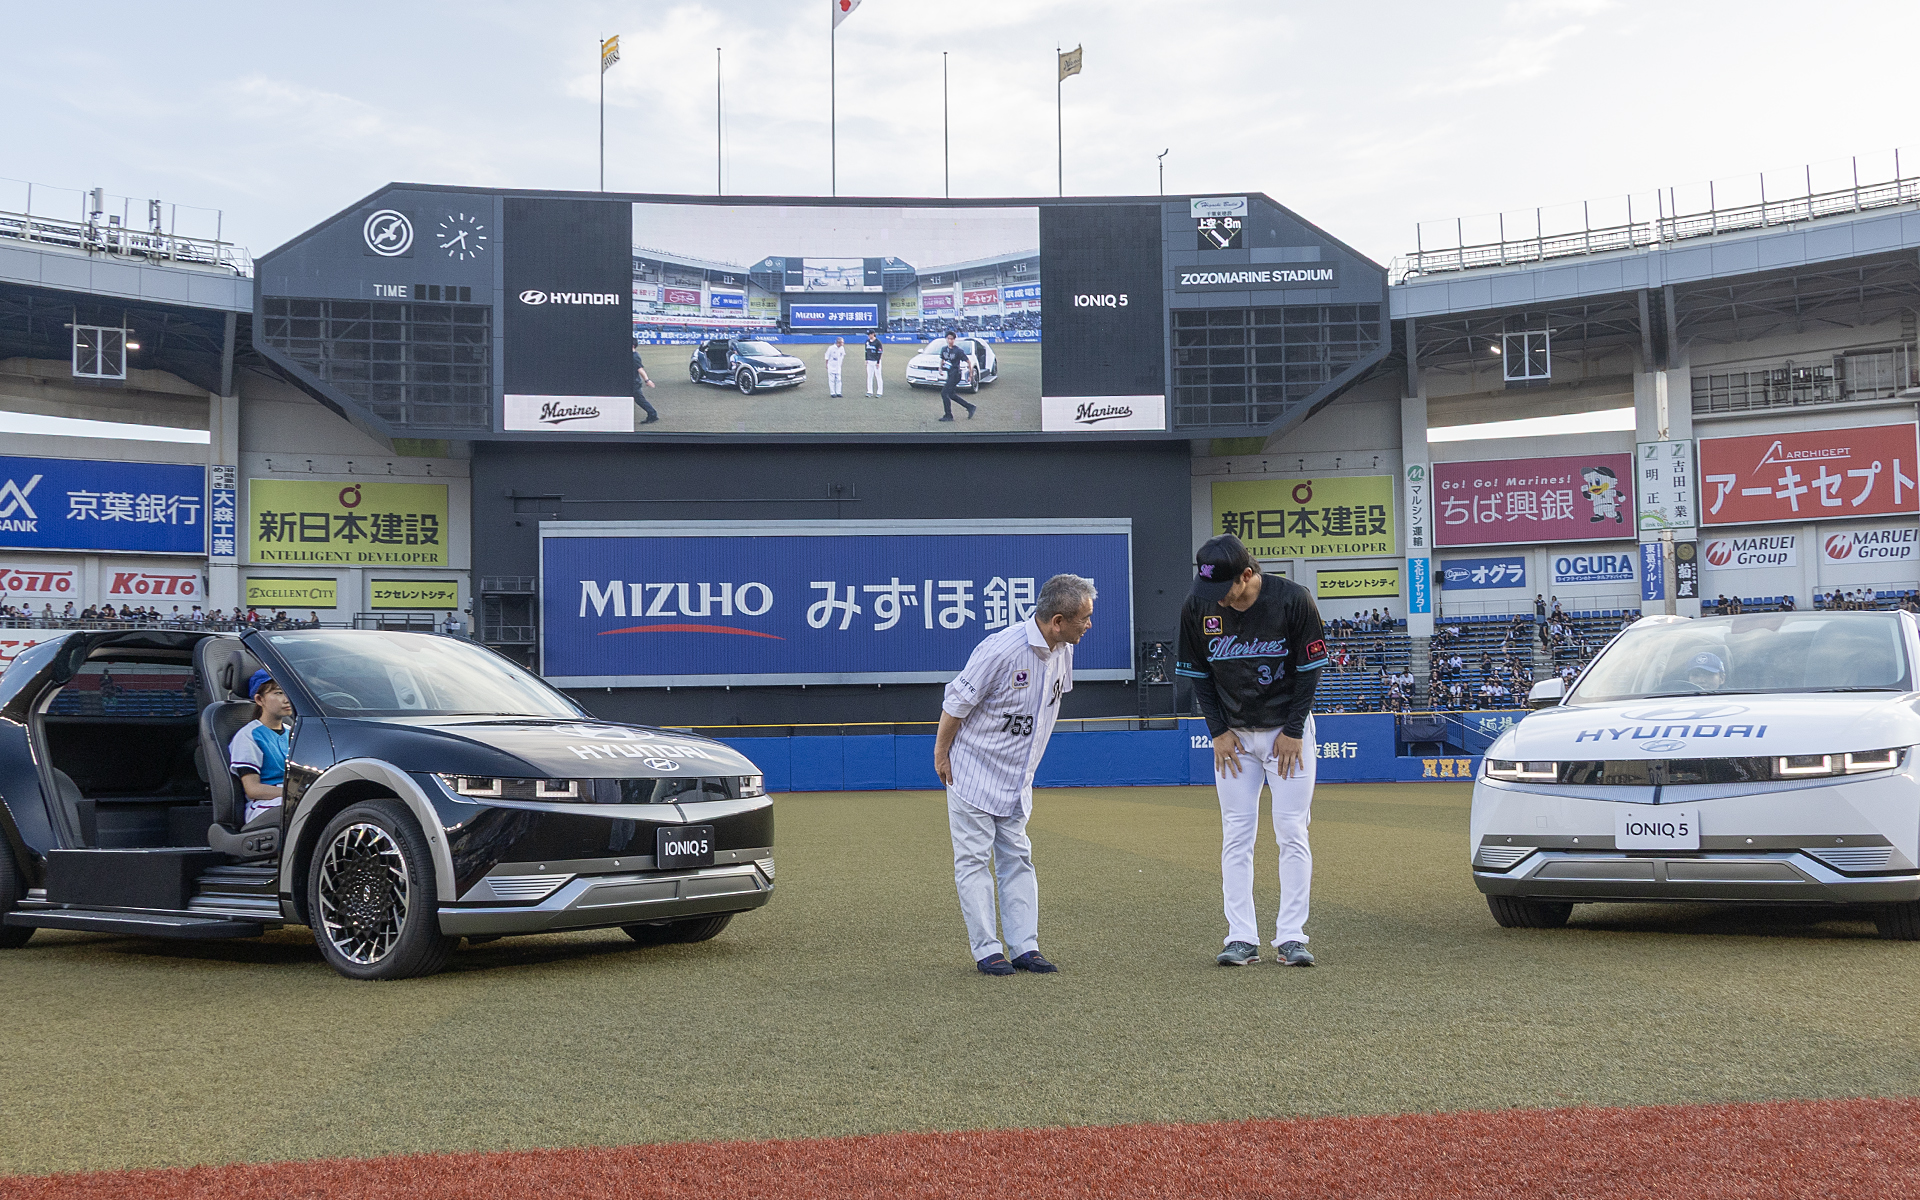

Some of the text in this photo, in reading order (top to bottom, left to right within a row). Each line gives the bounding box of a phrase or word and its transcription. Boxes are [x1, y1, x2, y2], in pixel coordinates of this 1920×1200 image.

[1198, 217, 1241, 229] 上空 8m
[1181, 269, 1333, 285] ZOZOMARINE STADIUM
[373, 284, 407, 298] TIME
[550, 292, 619, 305] HYUNDAI
[1074, 294, 1128, 308] IONIQ 5
[795, 311, 873, 321] MIZUHO みずほ銀行
[538, 402, 600, 425] Marines
[1074, 402, 1133, 425] Marines
[1786, 447, 1851, 459] ARCHICEPT
[1441, 475, 1572, 490] Go! Go! Marines!
[1645, 468, 1660, 504] 明正
[1671, 460, 1688, 518] 吉田工業
[1705, 458, 1915, 515] アーキセプト
[66, 489, 200, 525] 京葉銀行
[1440, 489, 1575, 525] ちば興銀
[213, 490, 234, 555] 大森工業
[1221, 504, 1387, 540] 新日本建設
[1411, 485, 1423, 547] マルシン運輸
[0, 519, 38, 533] ANK
[258, 510, 439, 546] 新日本建設
[1732, 536, 1795, 551] MARUEI
[1852, 528, 1918, 545] MARUEI
[260, 550, 439, 563] INTELLIGENT DEVELOPER
[1311, 543, 1387, 554] DEVELOPER
[1858, 545, 1911, 560] Group
[1555, 554, 1633, 575] OGURA
[1737, 552, 1788, 566] Group
[1471, 563, 1524, 584] オグラ
[1320, 578, 1396, 589] エクセレントシティ
[374, 590, 455, 600] エクセレントシティ
[579, 576, 1094, 631] MIZUHO みずほ銀
[1207, 635, 1289, 662] Marines
[1257, 662, 1286, 686] 34
[959, 675, 977, 695] LOTTE
[1001, 711, 1034, 737] 753
[1575, 723, 1768, 743] HYUNDAI
[566, 744, 714, 760] HYUNDAI
[1625, 822, 1689, 839] IONIQ 5
[664, 840, 708, 857] IONIQ 5
